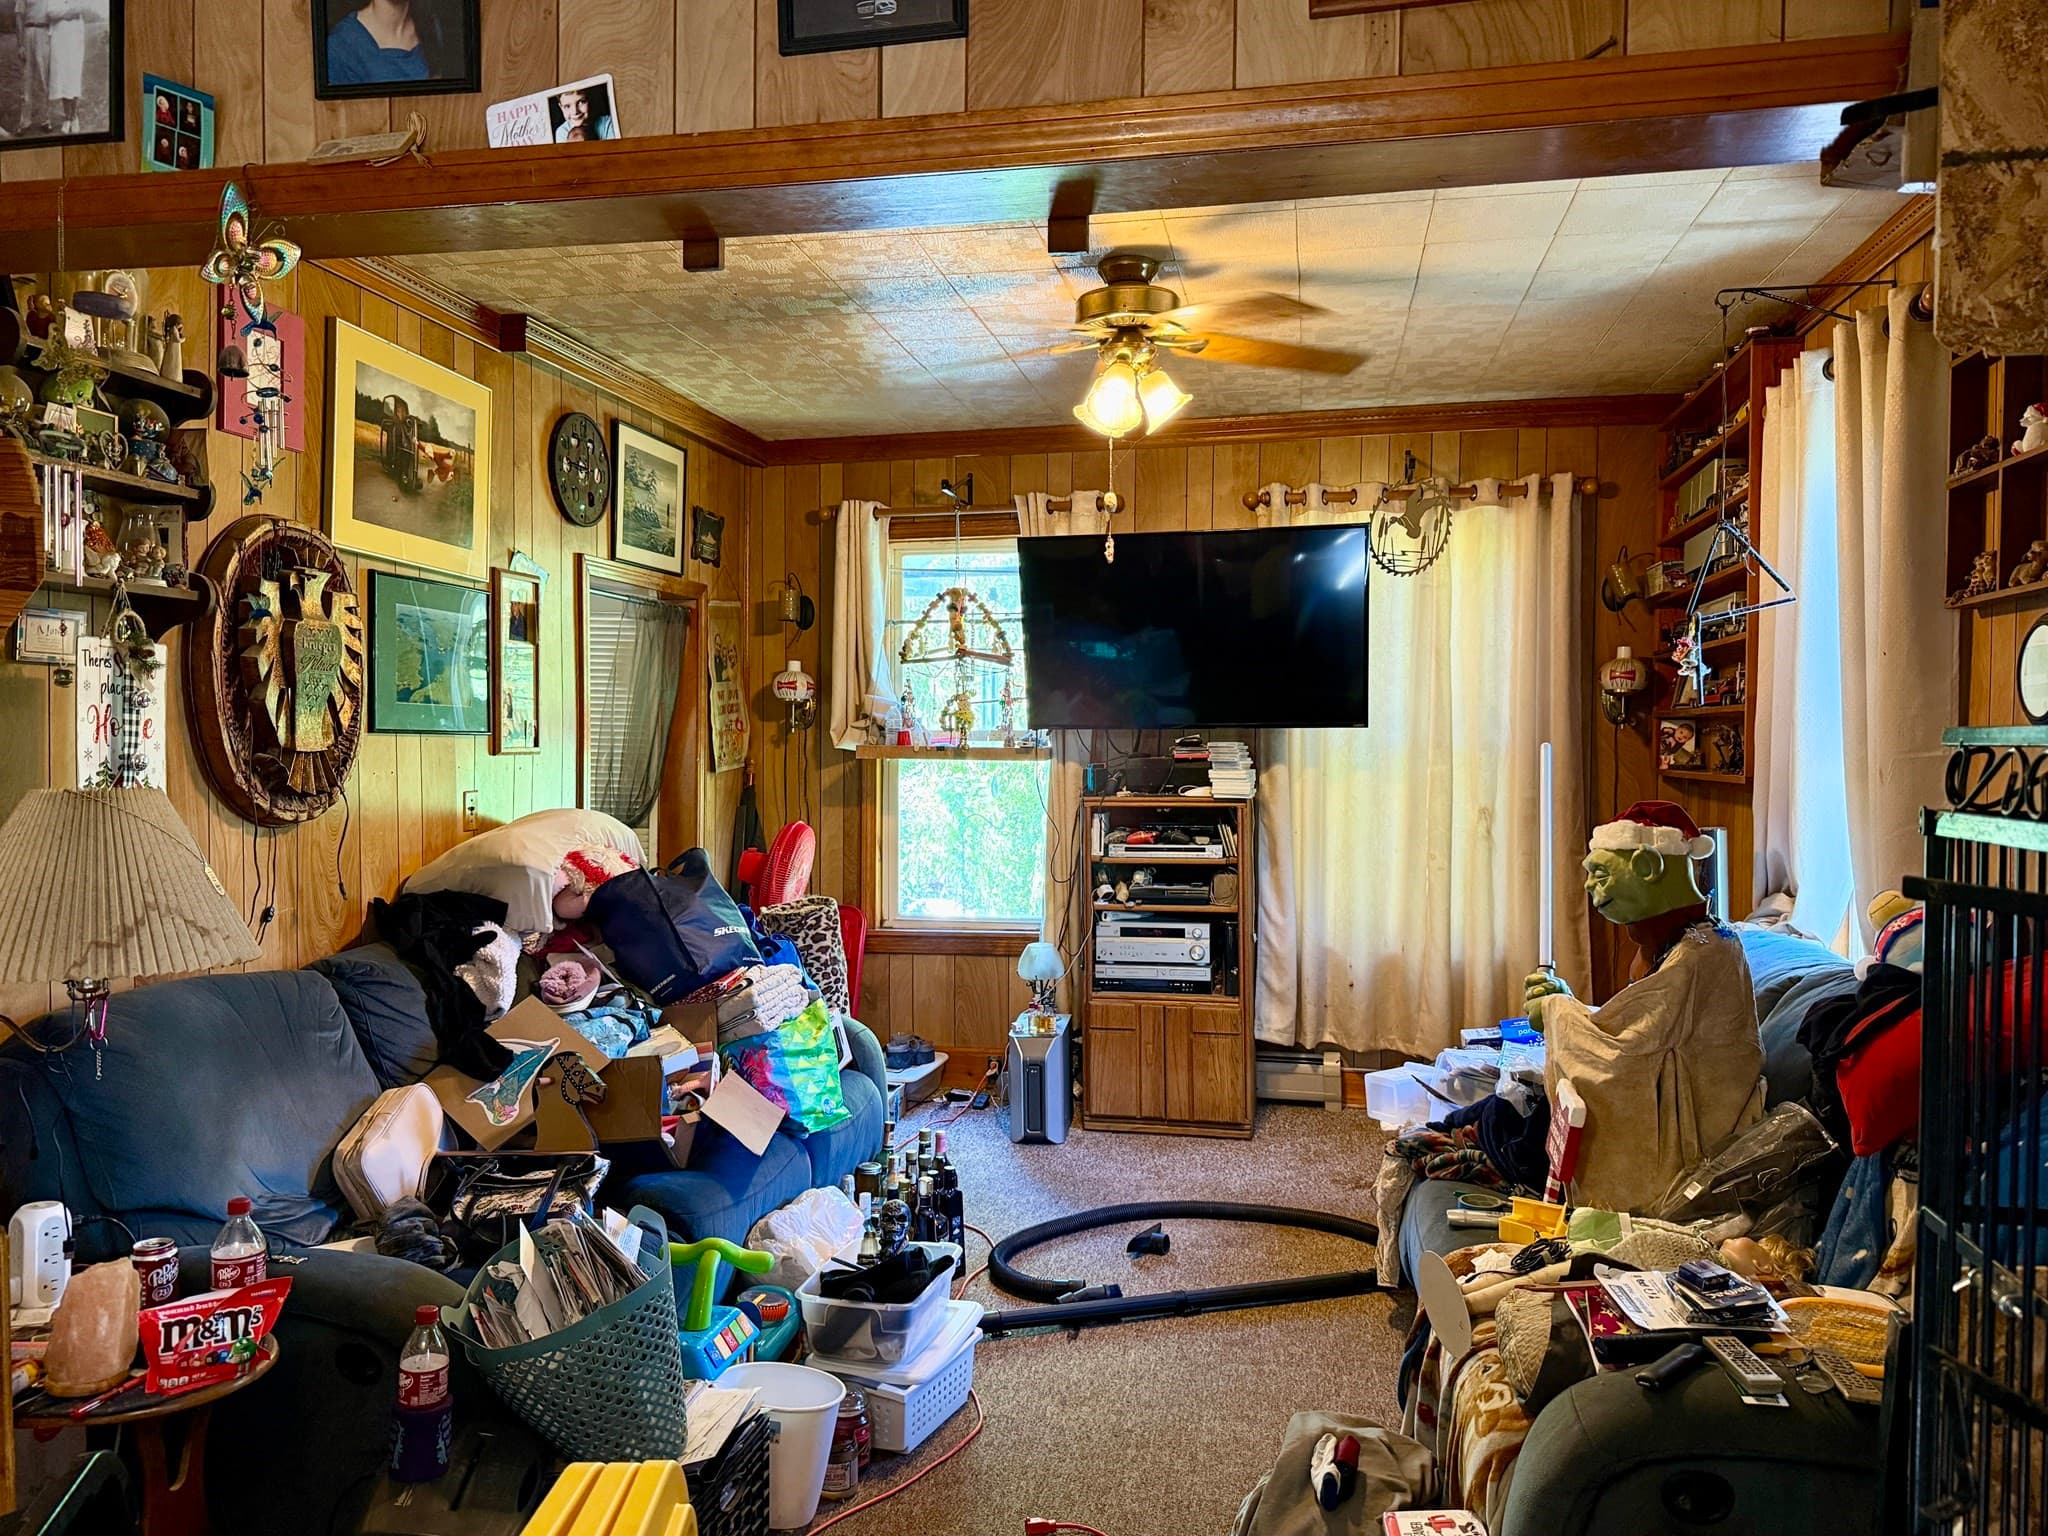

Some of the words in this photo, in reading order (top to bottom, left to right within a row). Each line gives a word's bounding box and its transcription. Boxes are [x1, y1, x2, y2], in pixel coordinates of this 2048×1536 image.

[497, 103, 540, 123] HAPPY
[82, 649, 112, 669] There's
[87, 704, 155, 747] Hoe
[713, 926, 750, 937] SKEC
